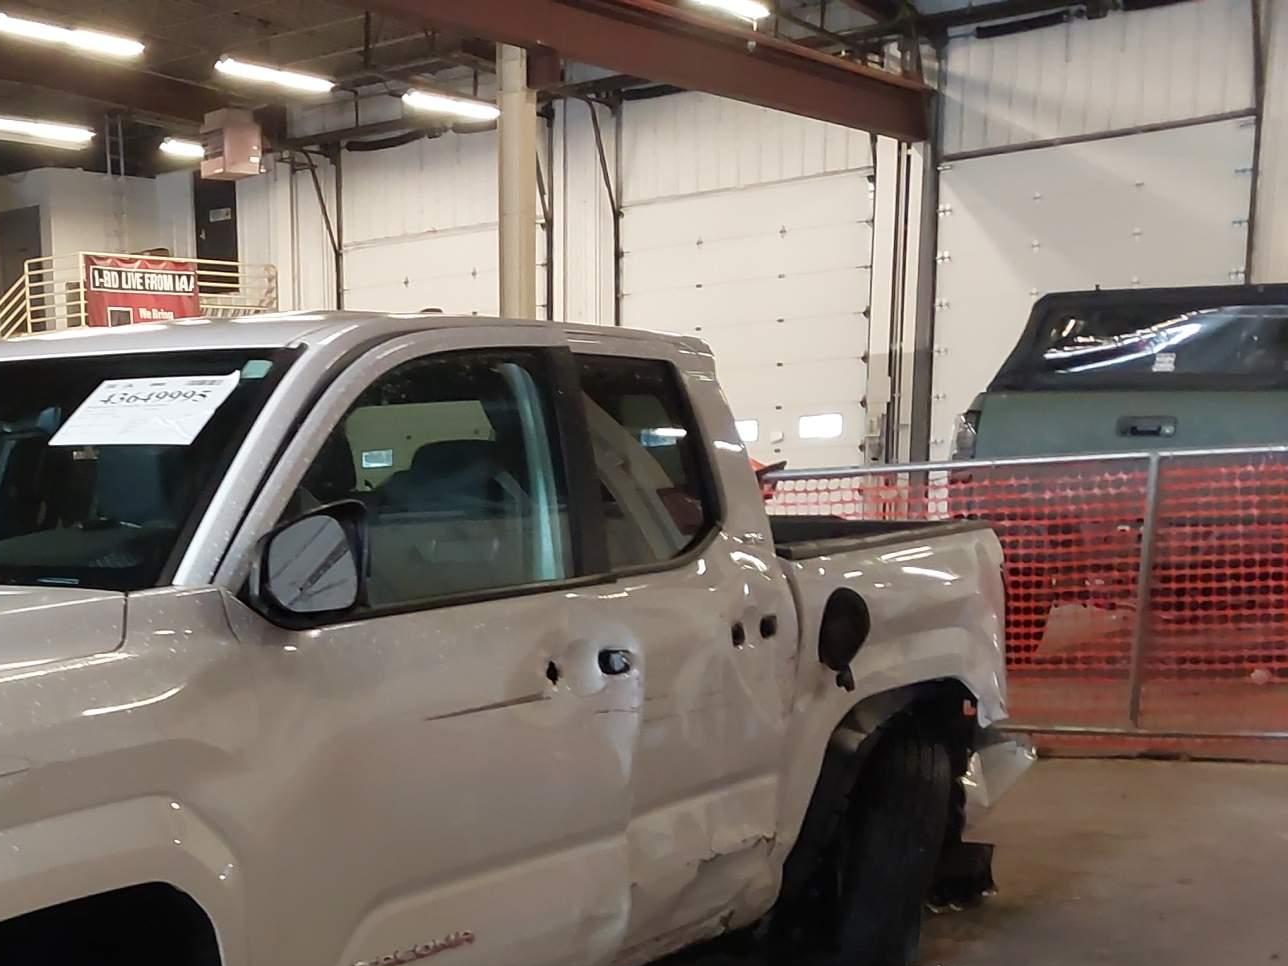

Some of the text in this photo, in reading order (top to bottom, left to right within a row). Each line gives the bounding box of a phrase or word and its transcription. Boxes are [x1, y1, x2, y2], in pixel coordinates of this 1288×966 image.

[121, 271, 143, 290] LIVE
[144, 273, 174, 291] FROM
[139, 307, 152, 319] We
